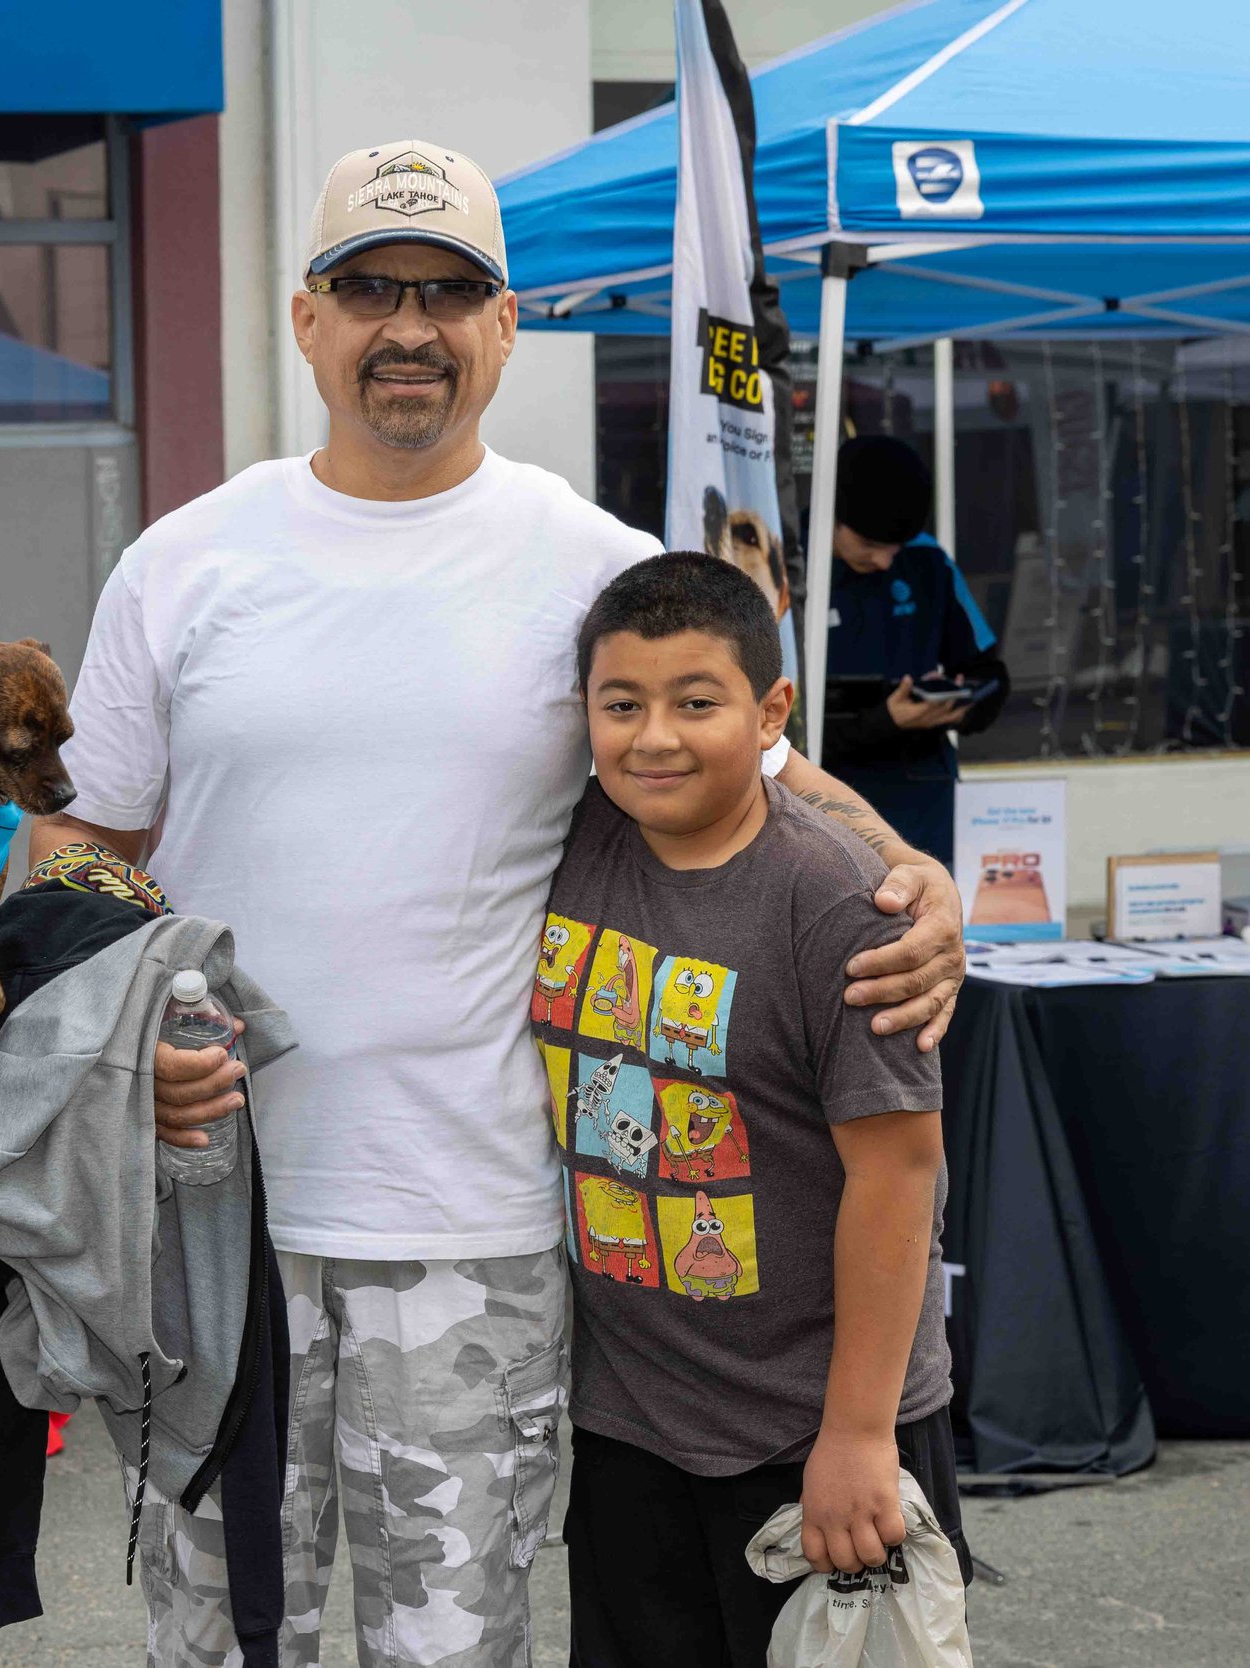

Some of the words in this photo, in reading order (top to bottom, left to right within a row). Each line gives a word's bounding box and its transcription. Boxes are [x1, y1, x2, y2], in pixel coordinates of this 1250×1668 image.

[347, 178, 392, 213] SIERRA
[395, 171, 470, 216] MOUNTAINS
[380, 191, 405, 202] LAKE
[408, 191, 439, 203] TAHOE
[709, 325, 747, 363] EE
[981, 852, 1041, 869] PRO
